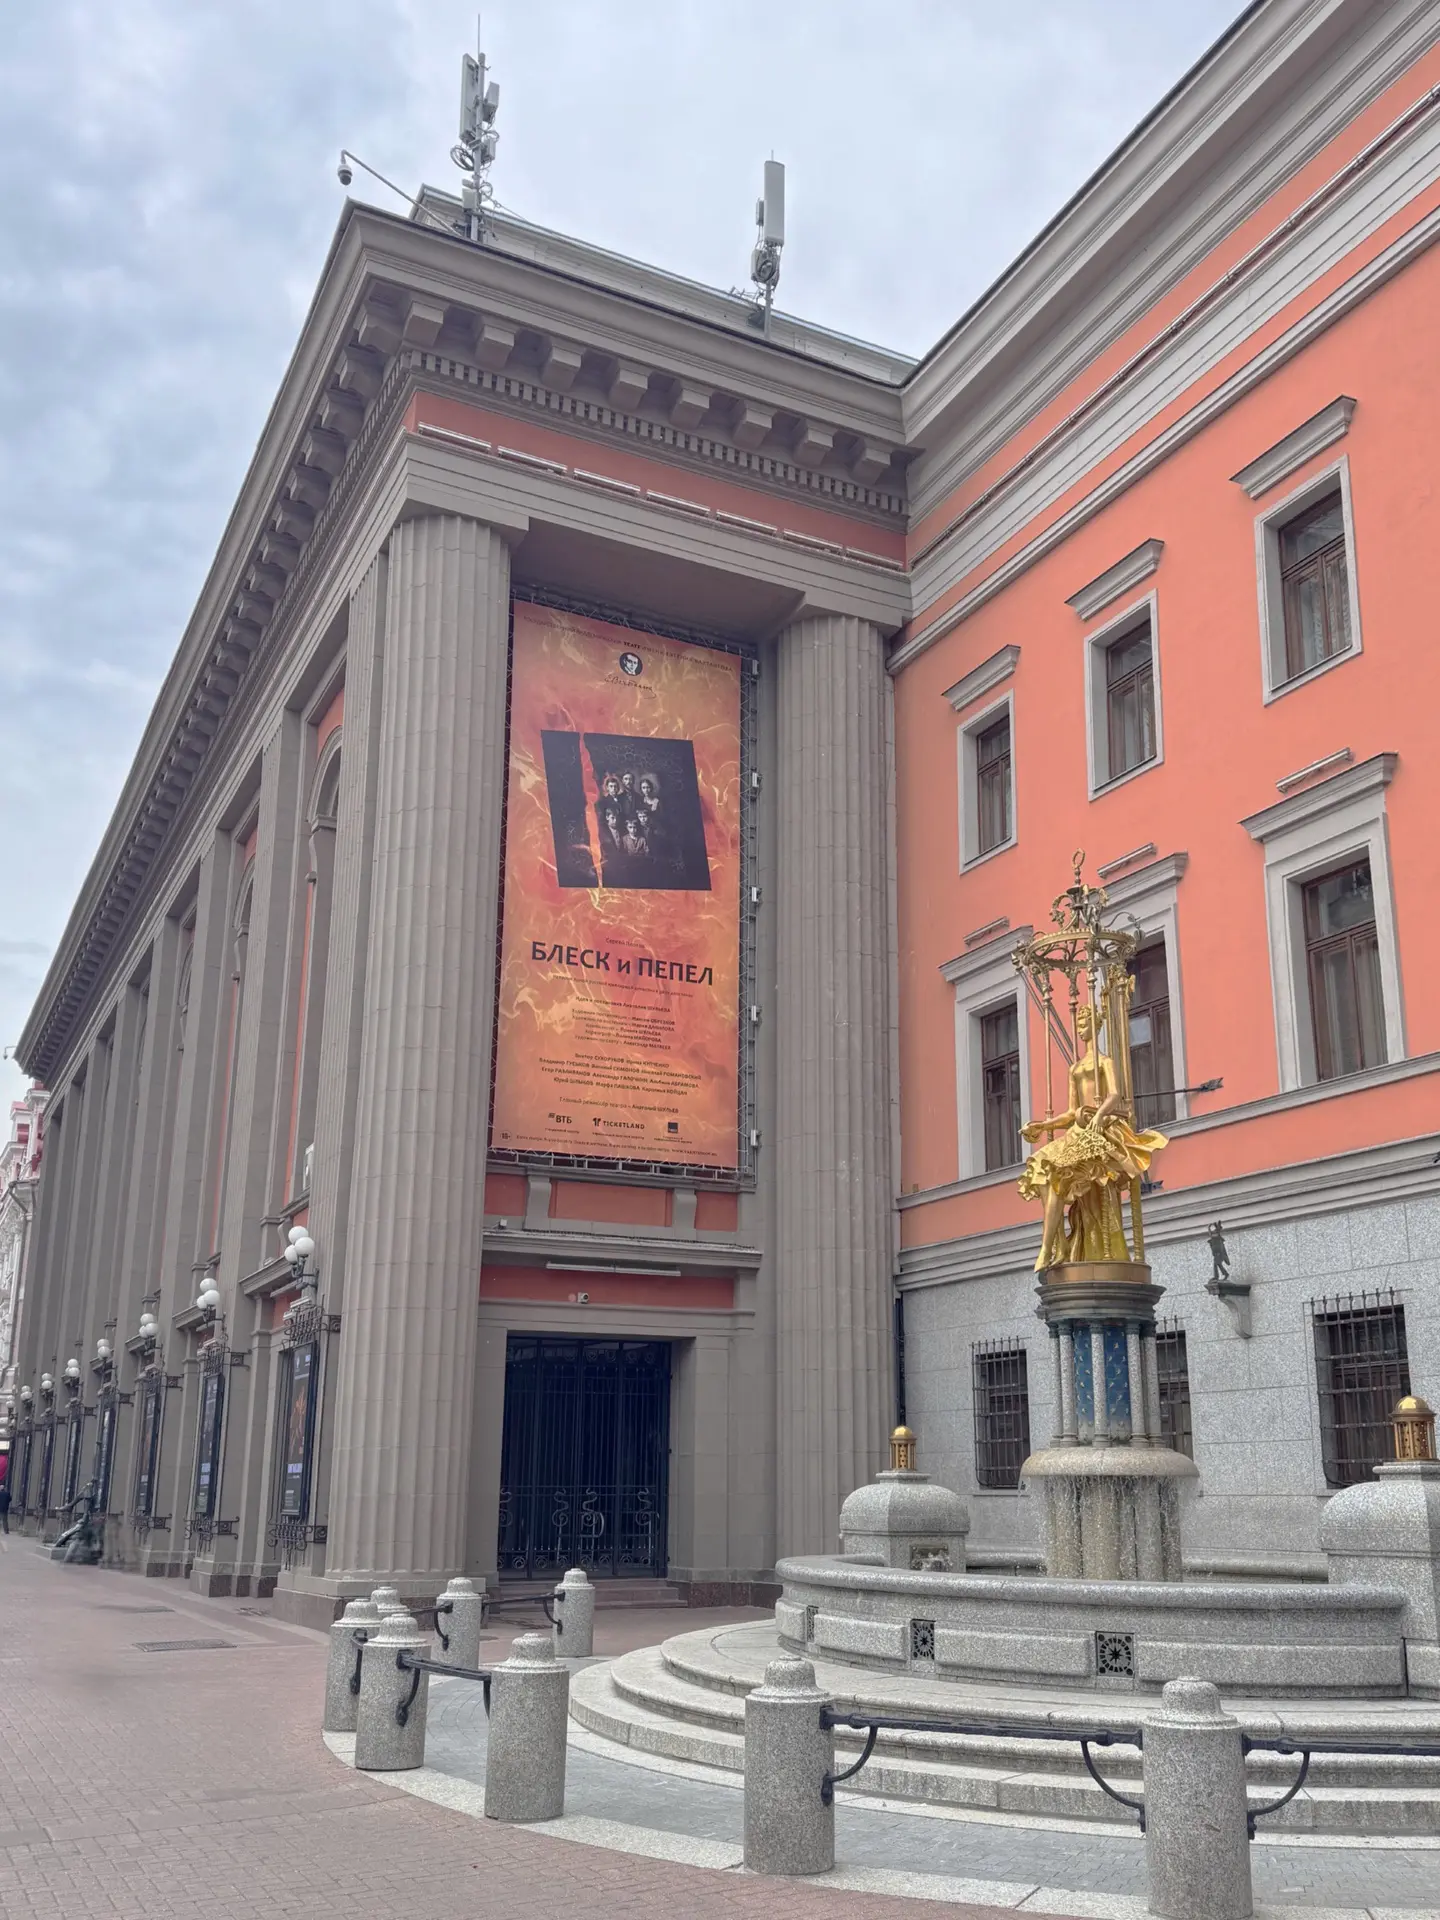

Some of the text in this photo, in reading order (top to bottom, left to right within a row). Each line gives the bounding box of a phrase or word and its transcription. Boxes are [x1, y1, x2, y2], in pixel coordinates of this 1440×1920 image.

[532, 941, 713, 985] БЛЕСК и ПЕПЕЛ
[556, 1115, 572, 1124] ВТБ
[603, 1121, 645, 1129] TICKETLAND
